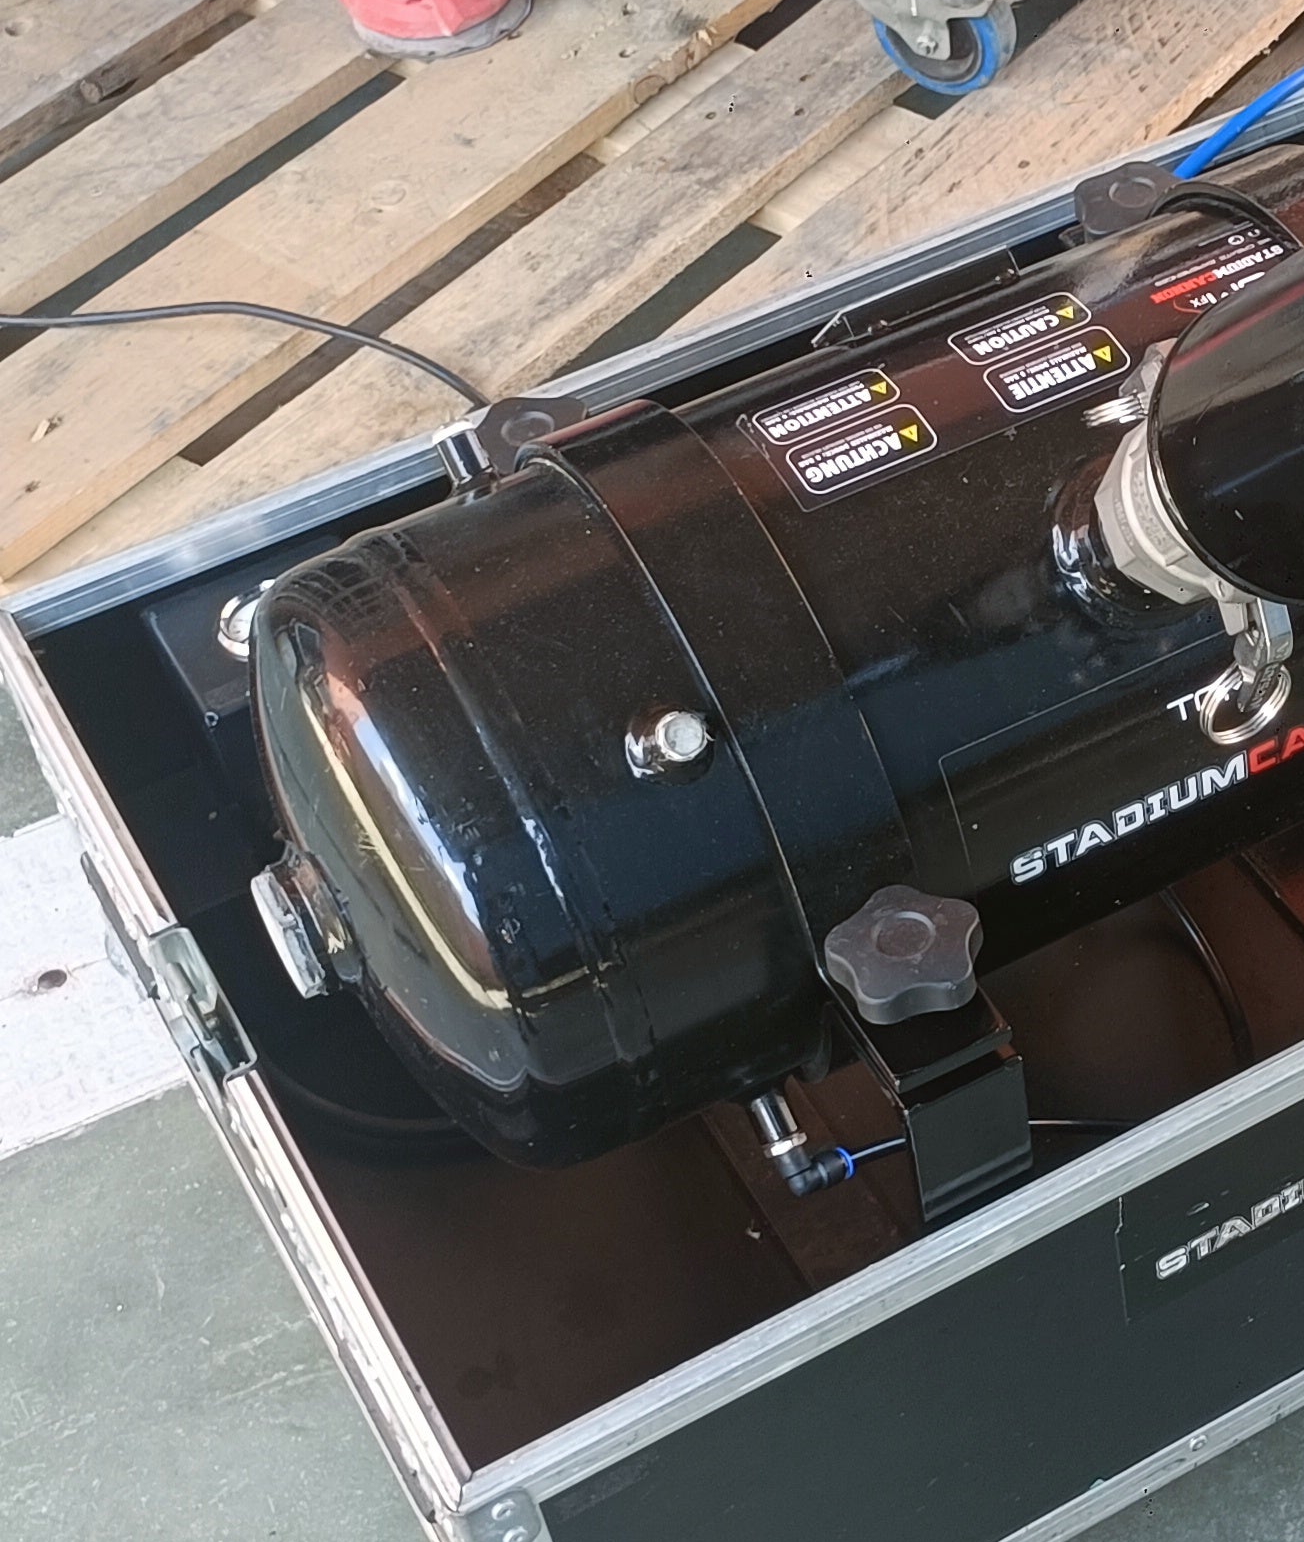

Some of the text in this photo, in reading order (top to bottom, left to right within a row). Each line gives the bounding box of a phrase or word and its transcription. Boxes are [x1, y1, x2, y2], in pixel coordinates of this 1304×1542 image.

[972, 314, 1060, 356] CAUTION
[1008, 353, 1097, 401] ATTENTIE
[768, 388, 872, 439] ATTENTION
[805, 432, 902, 483] ACHTUNG
